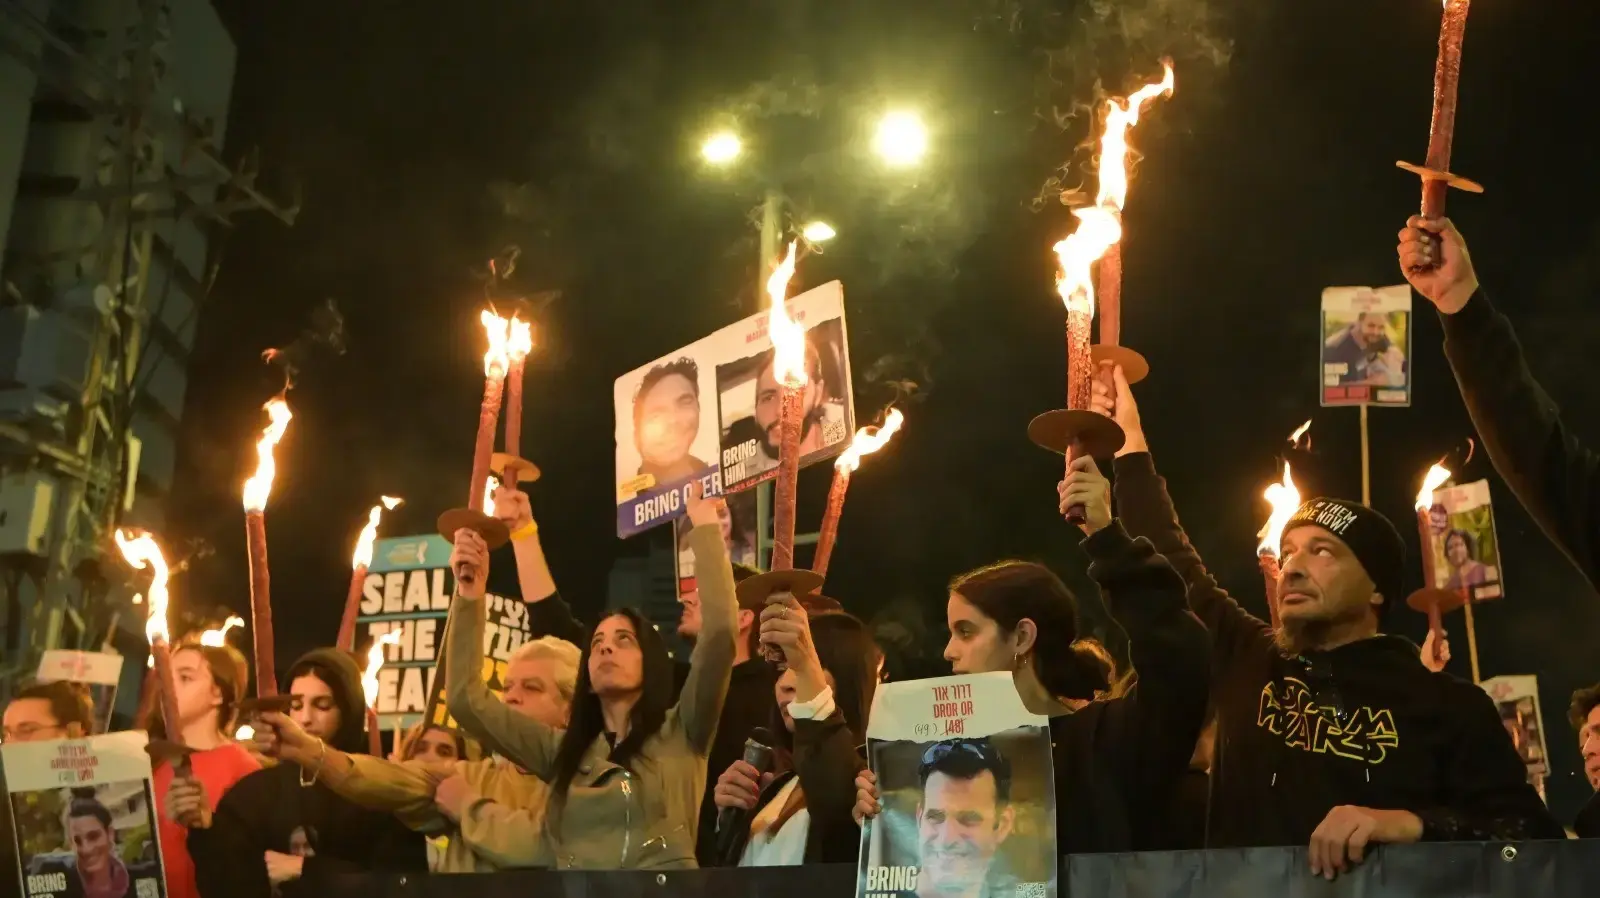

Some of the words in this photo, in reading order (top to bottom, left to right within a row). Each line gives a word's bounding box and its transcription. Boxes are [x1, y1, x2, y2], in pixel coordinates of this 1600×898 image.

[723, 438, 757, 467] BRING
[724, 463, 747, 487] HIM
[634, 488, 680, 526] BRING
[683, 471, 722, 504] OER
[1315, 511, 1349, 535] NOW!
[360, 568, 450, 615] SEAL
[368, 618, 437, 662] THE
[377, 666, 437, 714] EA
[932, 686, 949, 701] אור
[951, 684, 971, 700] דרור
[933, 702, 958, 719] DROR
[961, 700, 974, 716] OR
[27, 872, 66, 894] BRING
[865, 865, 917, 891] BRING
